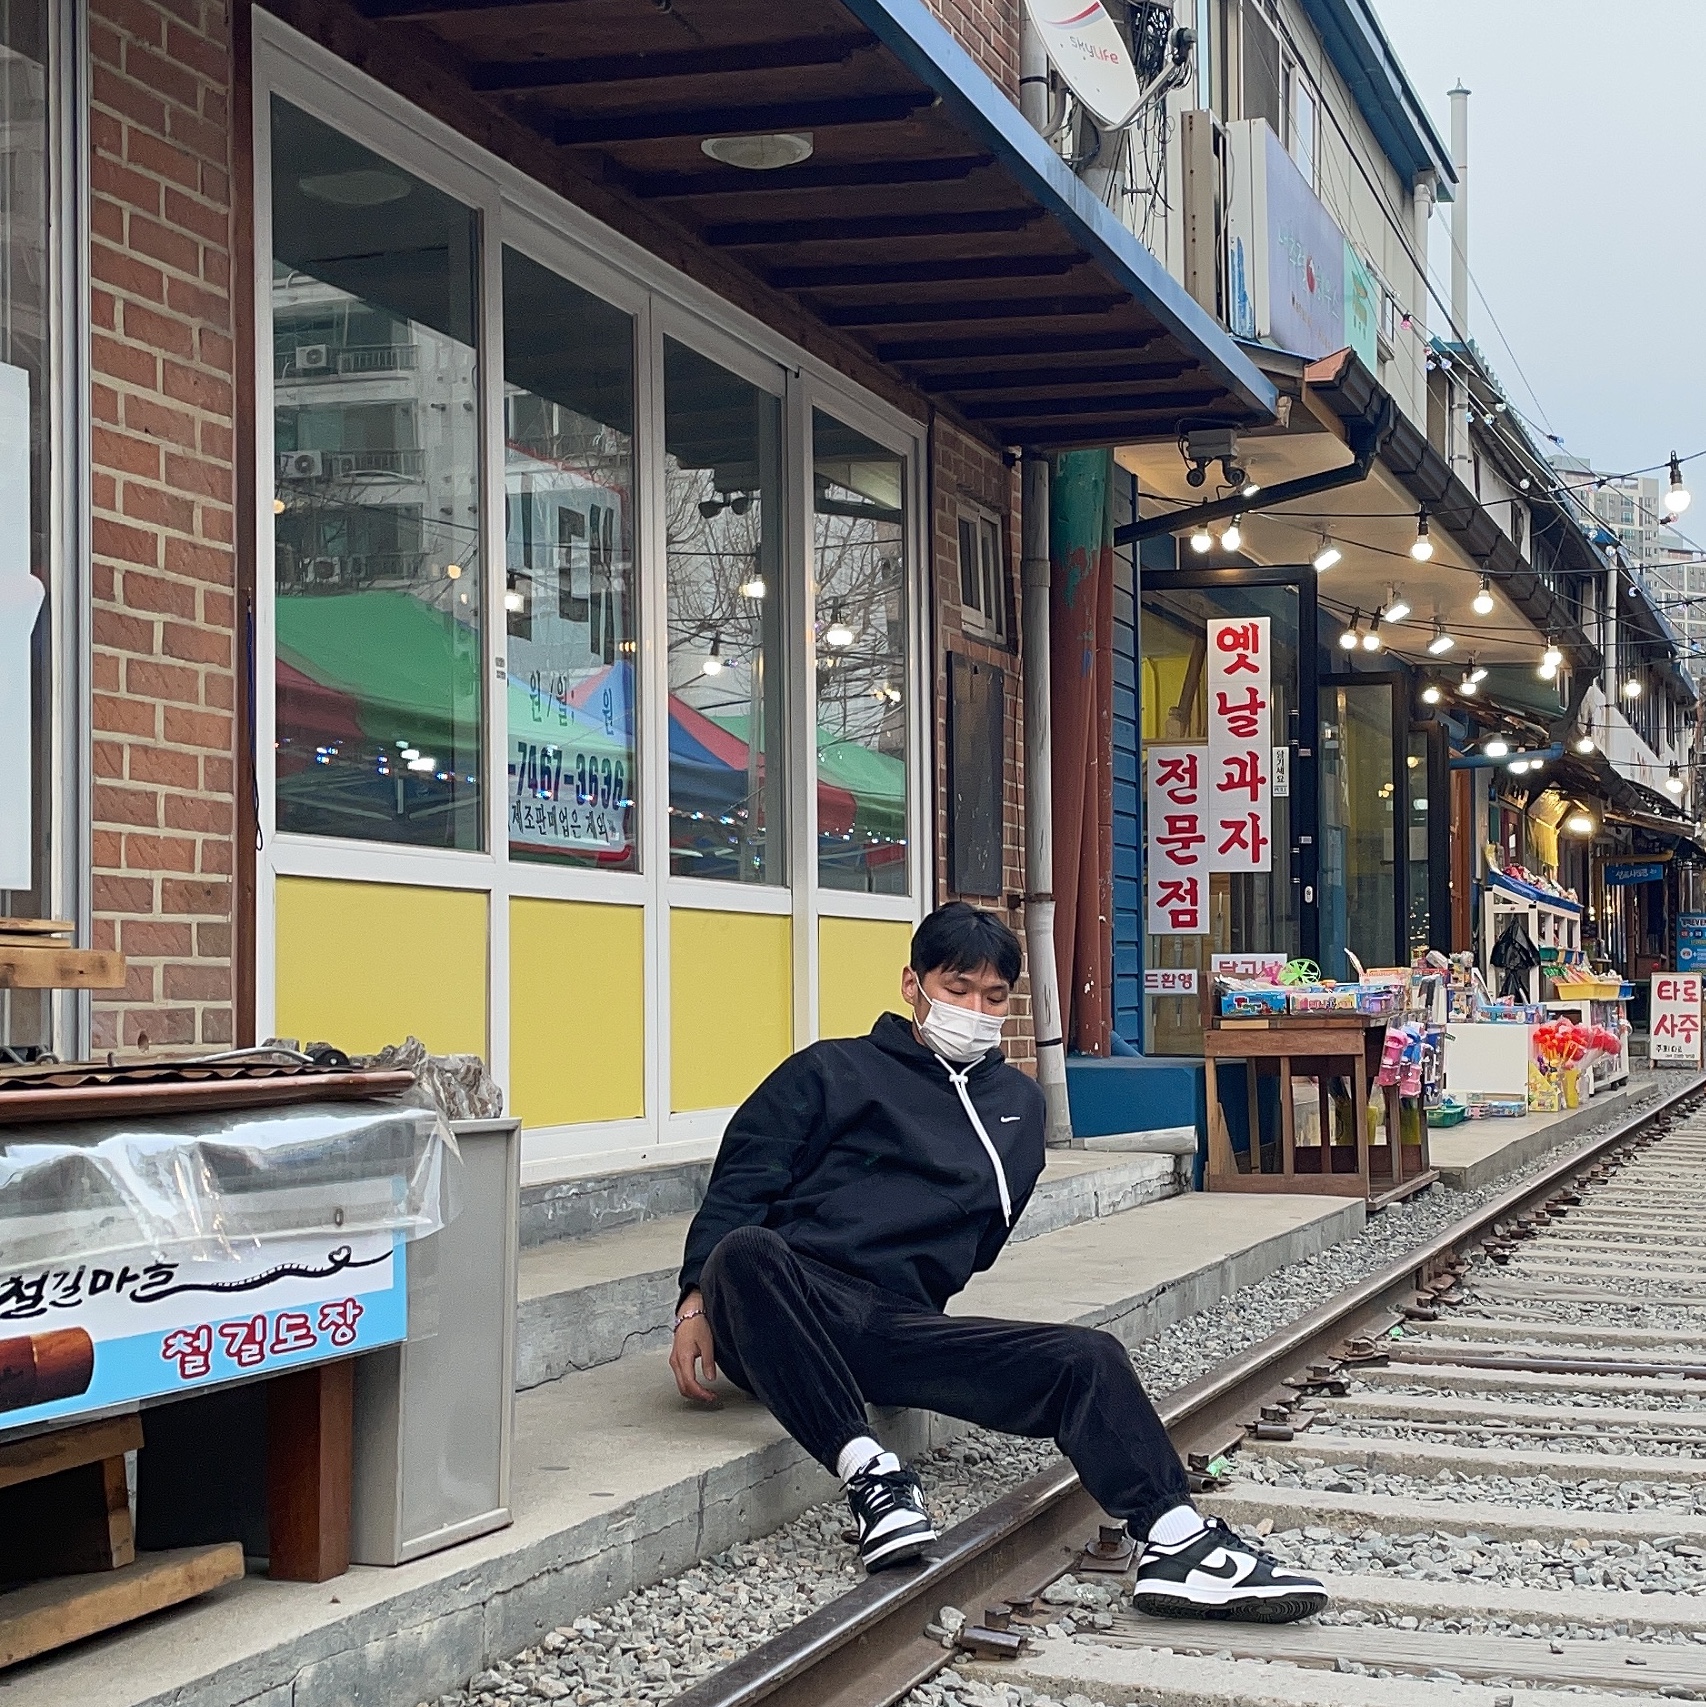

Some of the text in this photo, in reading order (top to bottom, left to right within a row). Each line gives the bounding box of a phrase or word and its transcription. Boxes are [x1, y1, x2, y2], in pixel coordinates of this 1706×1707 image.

[1216, 622, 1269, 865] 옛날과자
[1275, 750, 1285, 783] 당기세요
[1155, 753, 1206, 929] 전문점
[1656, 980, 1698, 1003] 타로
[1653, 1013, 1699, 1044] 사주
[162, 1297, 364, 1379] 철길도장
